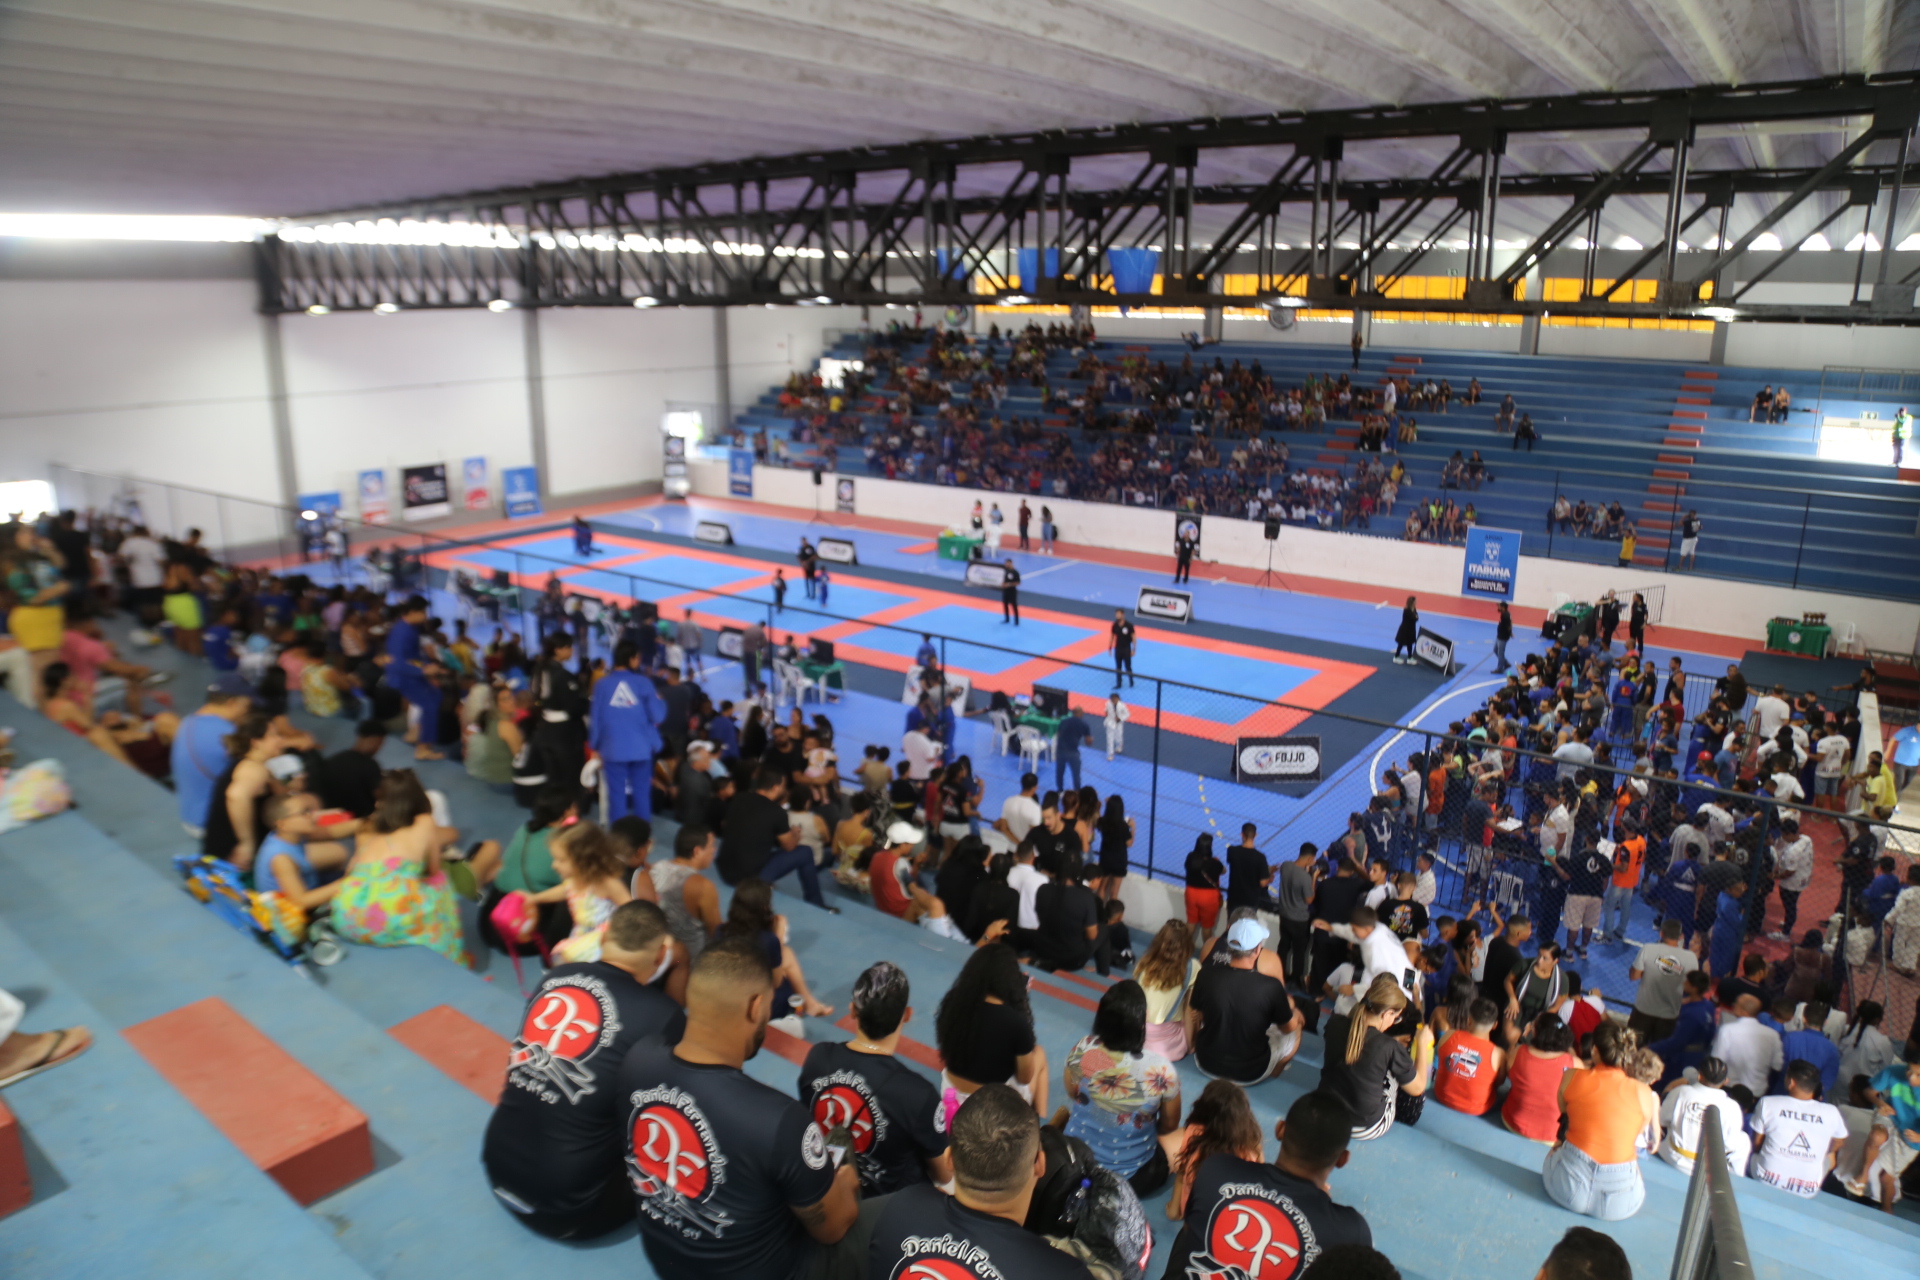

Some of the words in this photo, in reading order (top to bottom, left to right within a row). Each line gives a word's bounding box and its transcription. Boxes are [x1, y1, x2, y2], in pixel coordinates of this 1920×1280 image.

[1468, 563, 1511, 578] ITABUNA
[542, 973, 593, 991] Daniel
[585, 977, 624, 1048] Fernandes
[811, 1068, 856, 1092] Daniel
[850, 1074, 890, 1142] Fernandes
[1779, 1109, 1824, 1125] ATLETA
[630, 1083, 681, 1108] Daniel
[676, 1091, 729, 1185] Fernandes
[1219, 1182, 1278, 1201] Daniel
[901, 1233, 971, 1260] Daniel
